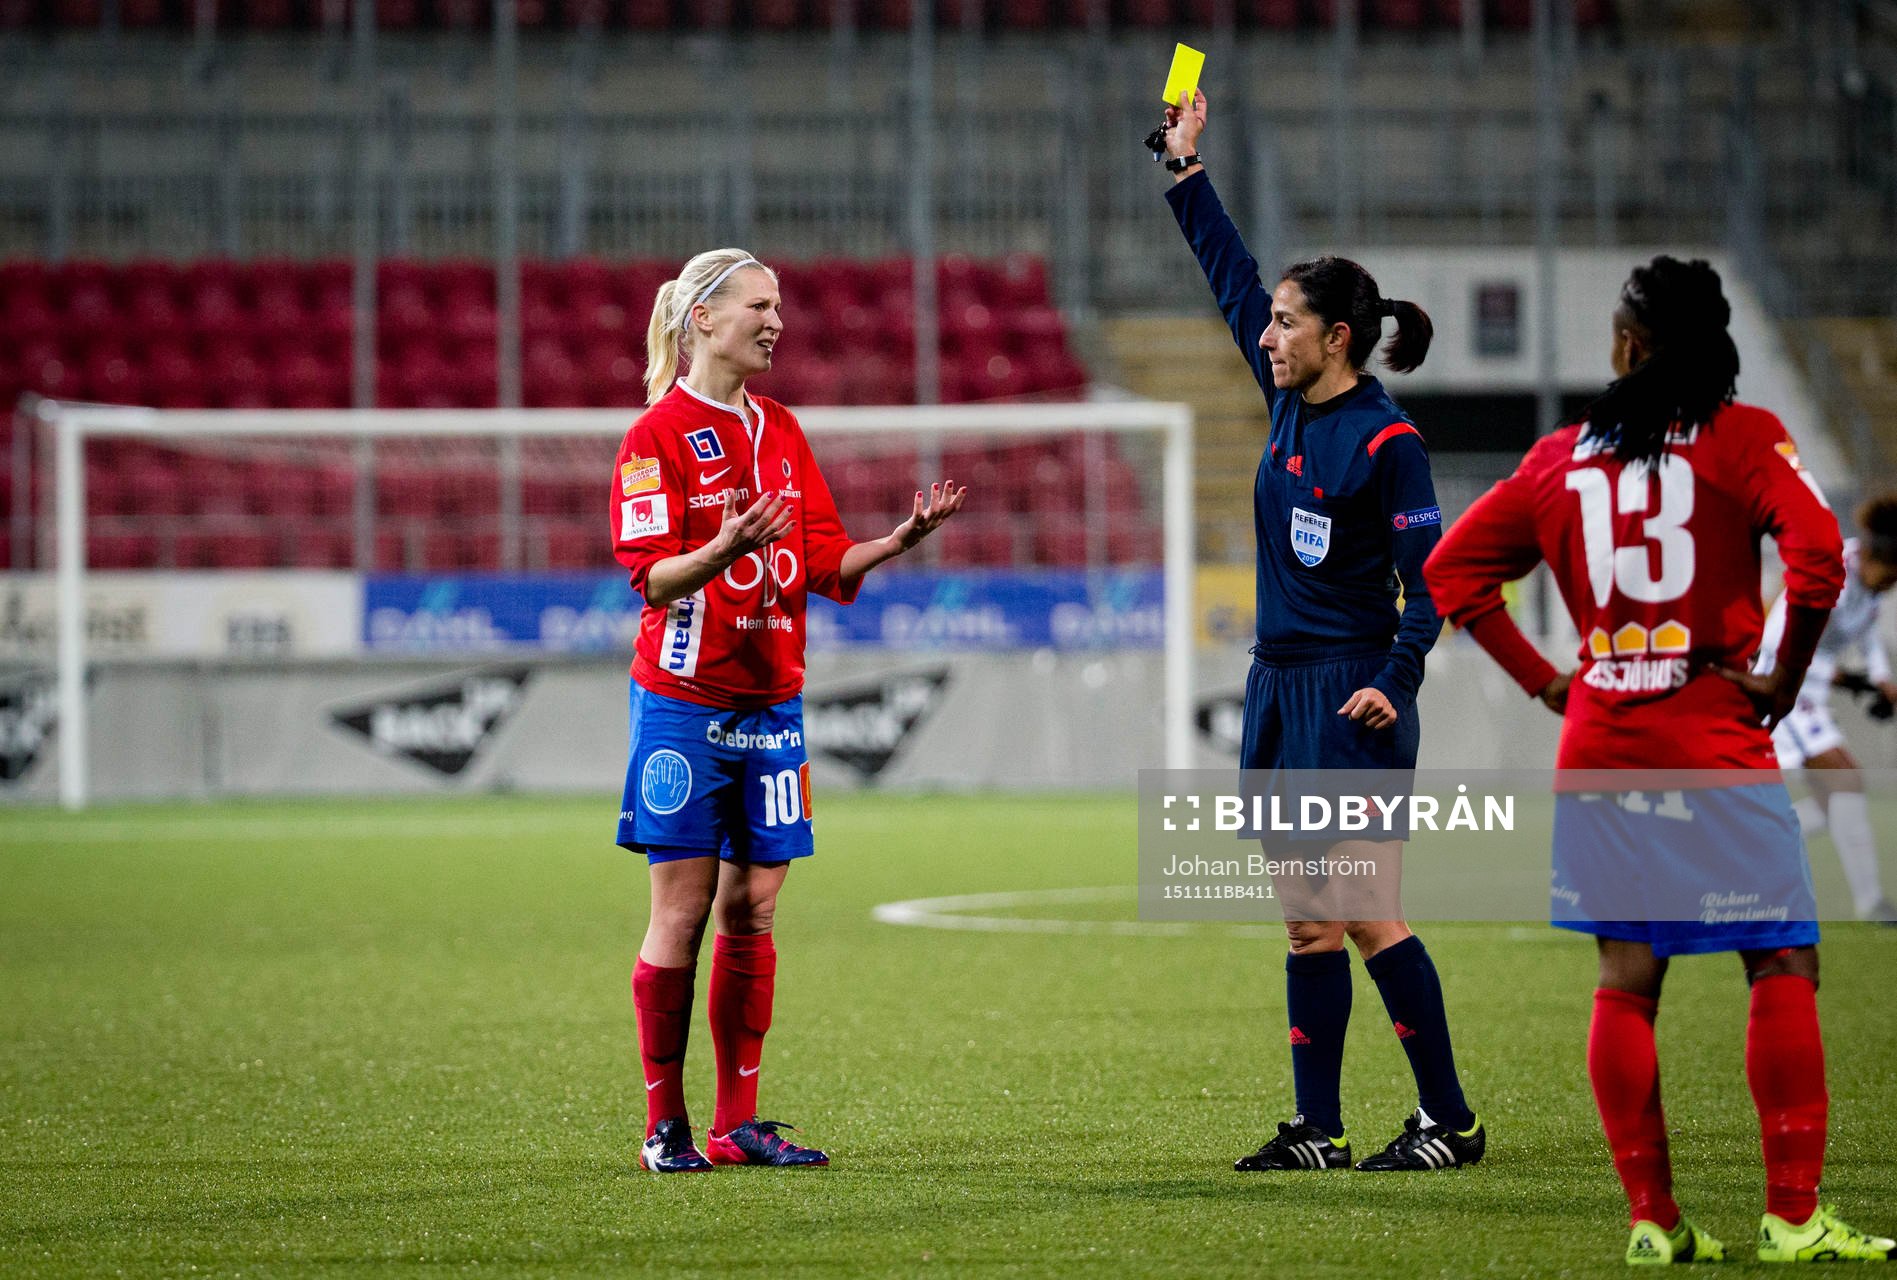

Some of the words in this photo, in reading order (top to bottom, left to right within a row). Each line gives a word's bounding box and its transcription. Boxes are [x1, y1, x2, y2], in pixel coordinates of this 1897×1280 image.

[1294, 512, 1329, 530] REFEREE
[1408, 510, 1441, 524] RESPECT
[1295, 529, 1325, 549] FIFA
[1565, 453, 1696, 609] 13
[1301, 554, 1317, 564] 2015
[735, 616, 765, 630] Hem
[767, 615, 780, 630] för
[780, 615, 793, 632] dig
[760, 769, 801, 827] 10
